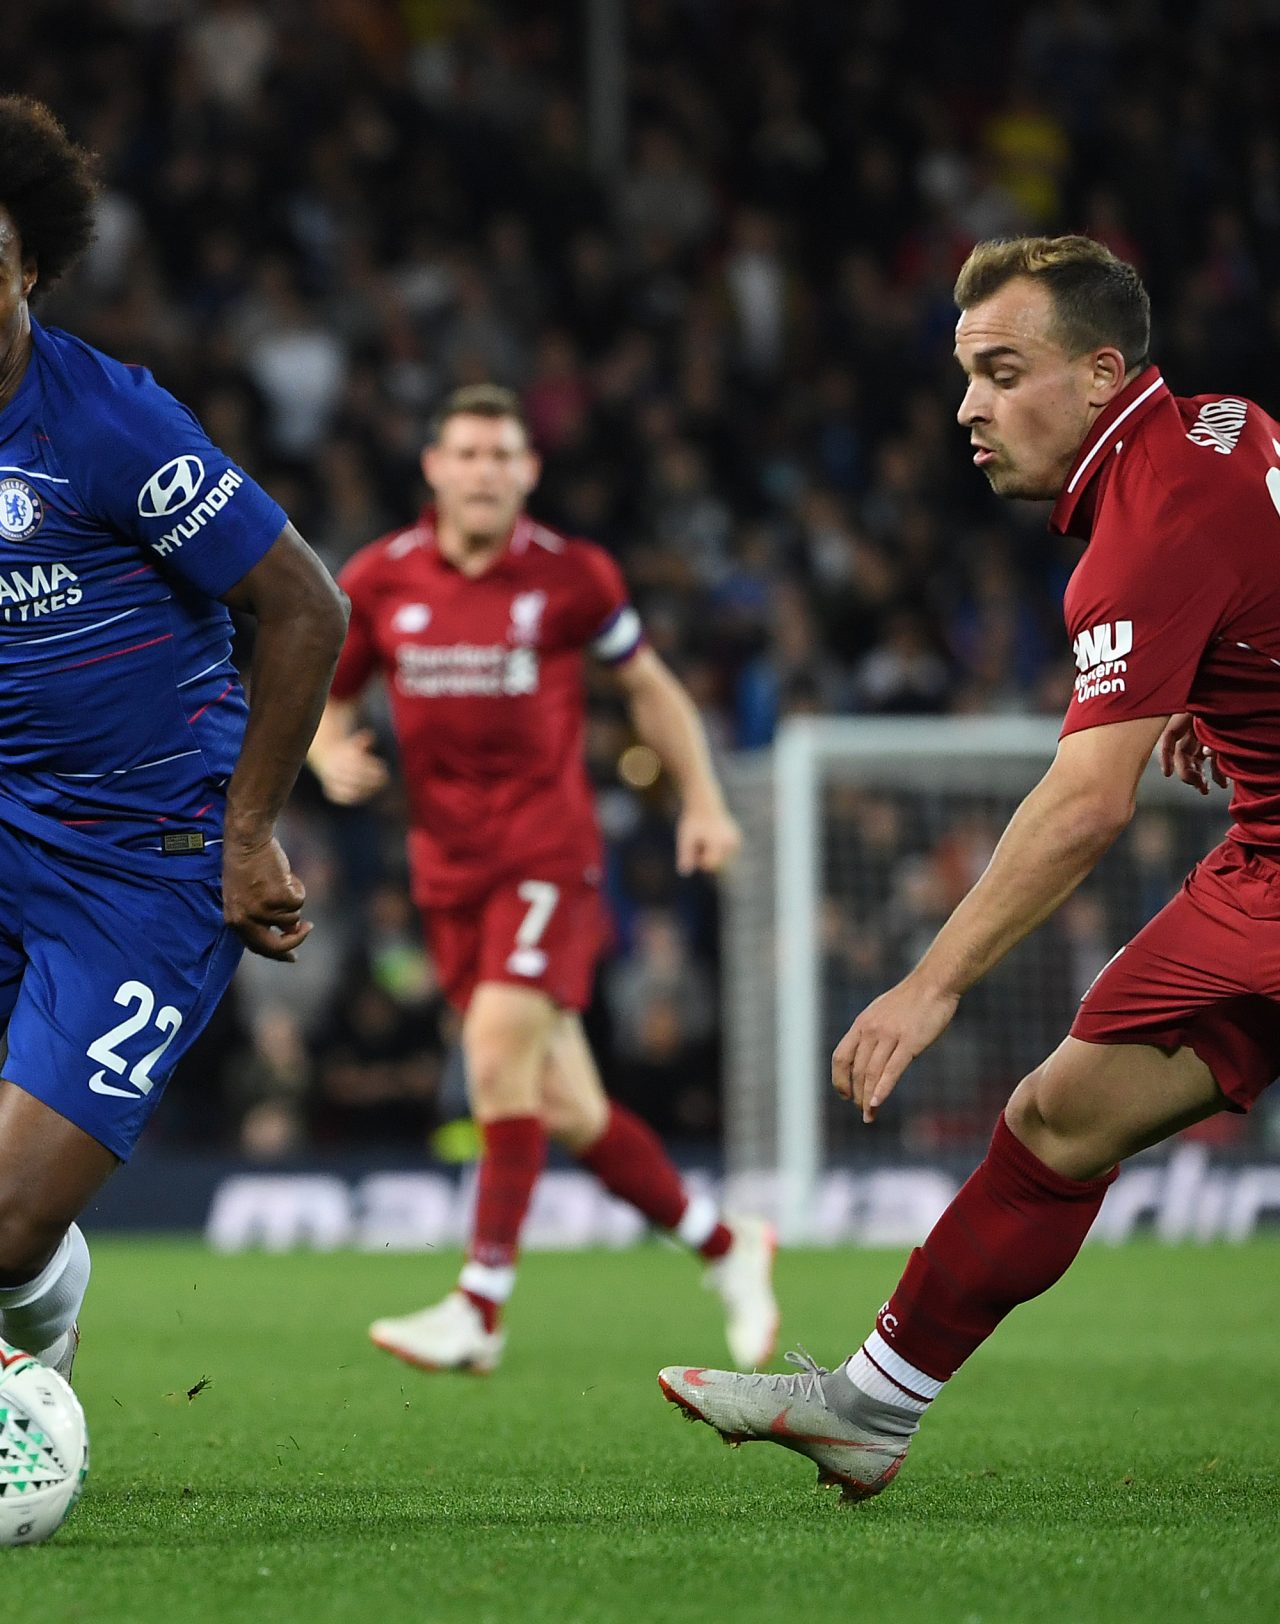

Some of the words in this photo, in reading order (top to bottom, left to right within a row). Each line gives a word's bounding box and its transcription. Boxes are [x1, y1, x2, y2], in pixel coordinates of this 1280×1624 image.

[151, 468, 243, 556] HYUNDAI
[1078, 678, 1126, 704] Union
[516, 879, 560, 948] 7
[86, 980, 183, 1096] 22
